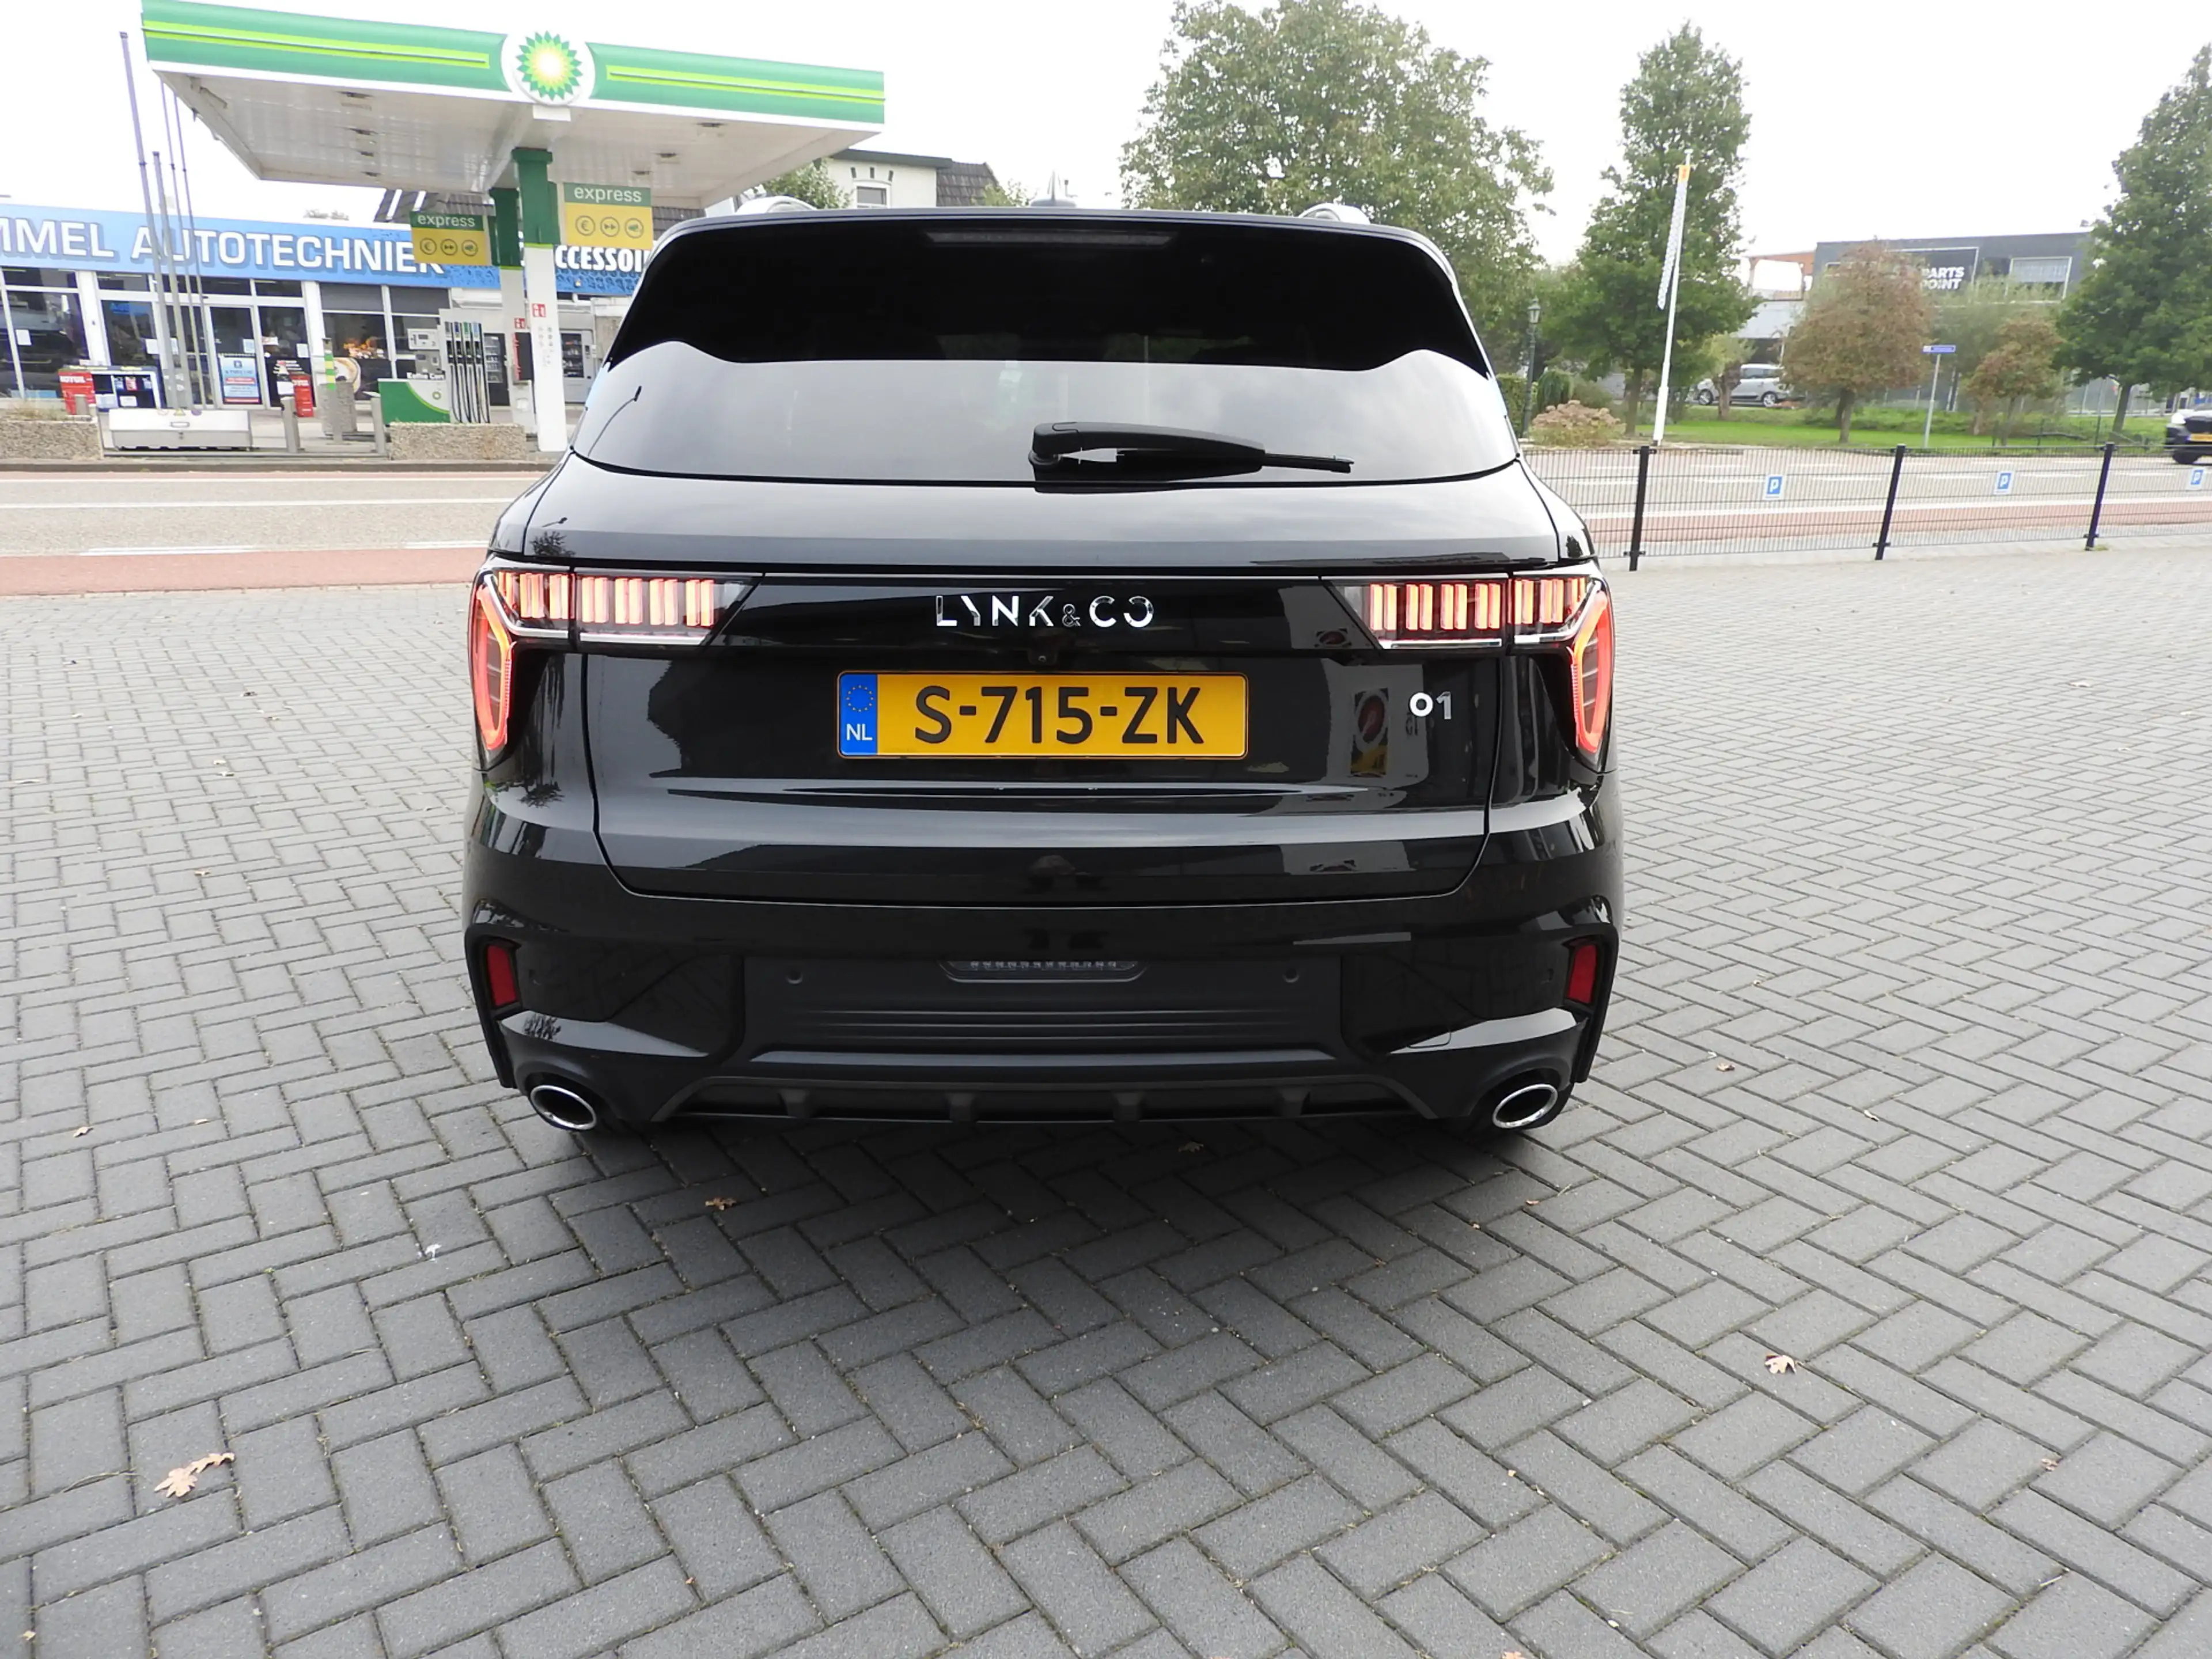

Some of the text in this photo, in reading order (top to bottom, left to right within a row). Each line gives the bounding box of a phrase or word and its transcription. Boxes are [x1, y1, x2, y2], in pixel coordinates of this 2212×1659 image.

[574, 186, 642, 203] express
[418, 214, 475, 228] express
[555, 244, 650, 272] CCESSOI
[846, 685, 1205, 744] NL S-715-ZK
